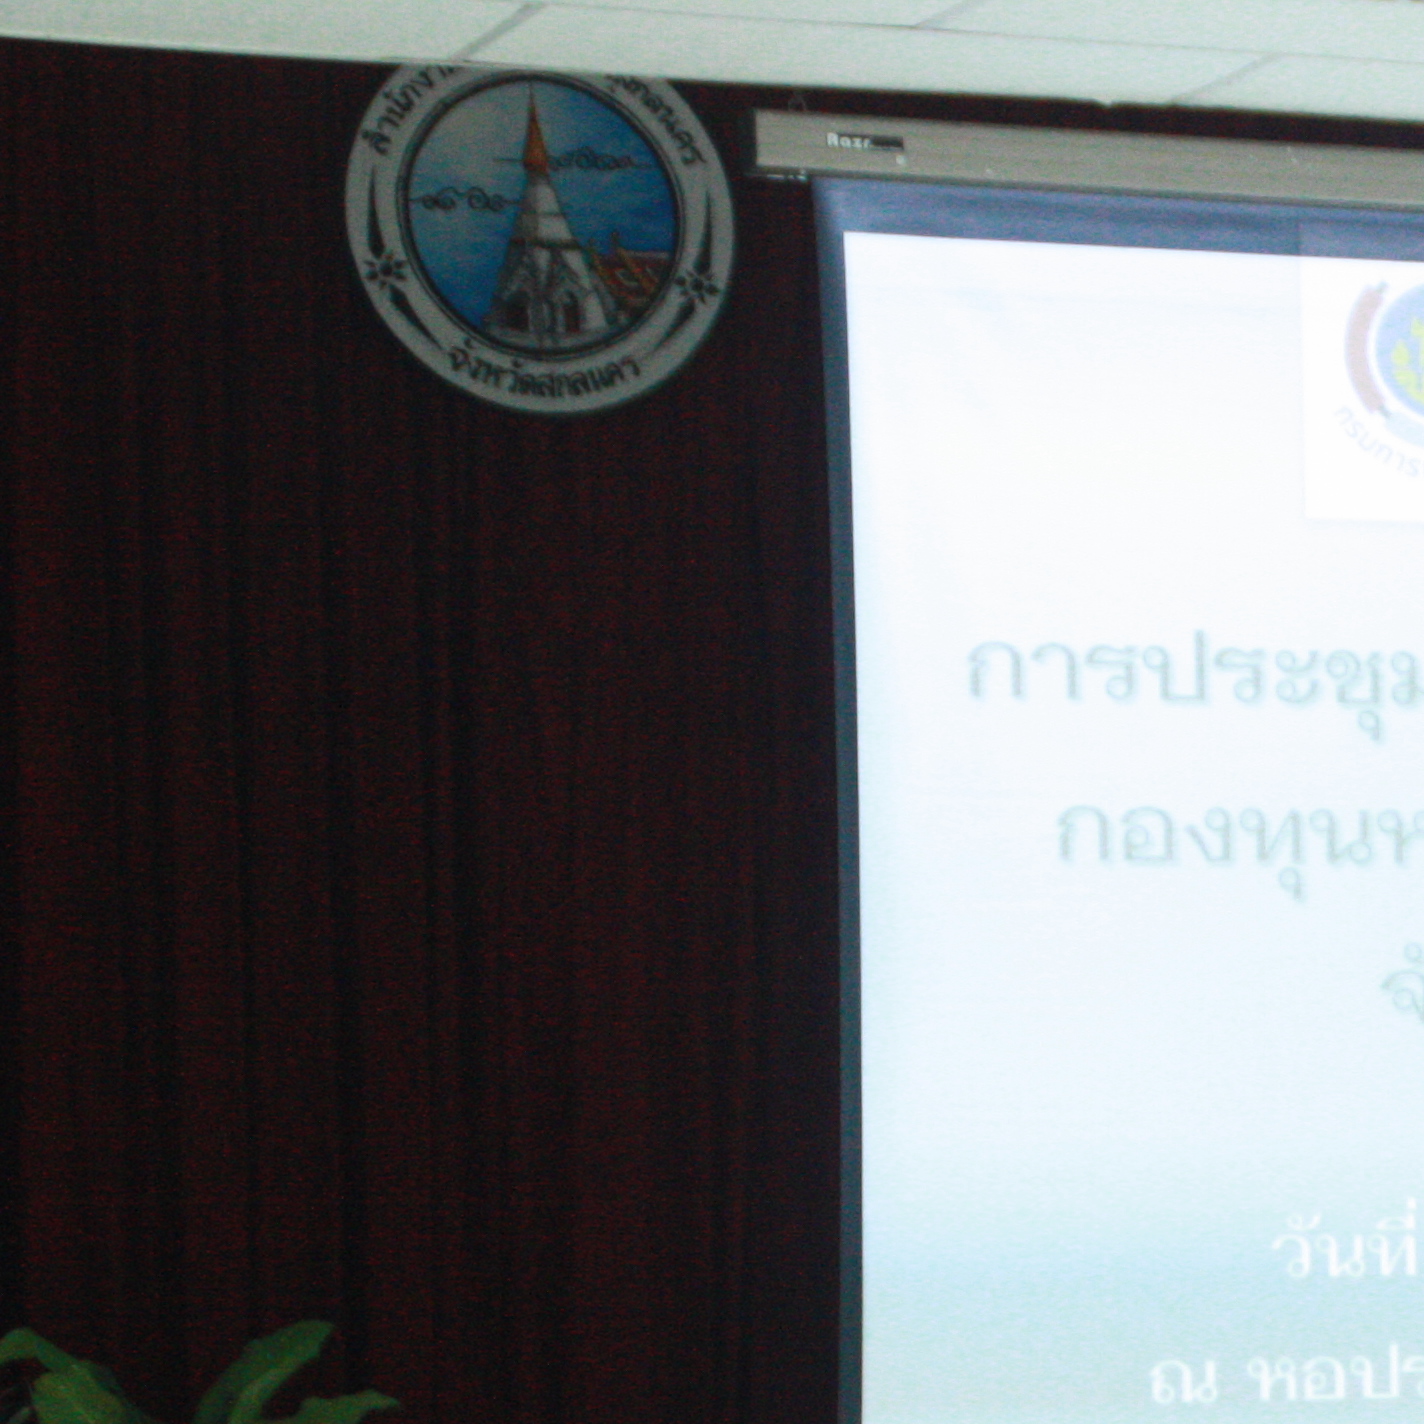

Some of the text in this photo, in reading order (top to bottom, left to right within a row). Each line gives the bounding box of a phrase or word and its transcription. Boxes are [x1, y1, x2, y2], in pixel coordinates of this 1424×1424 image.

[1271, 1196, 1419, 1279] วันที่
[1149, 1355, 1219, 1406] ณ
